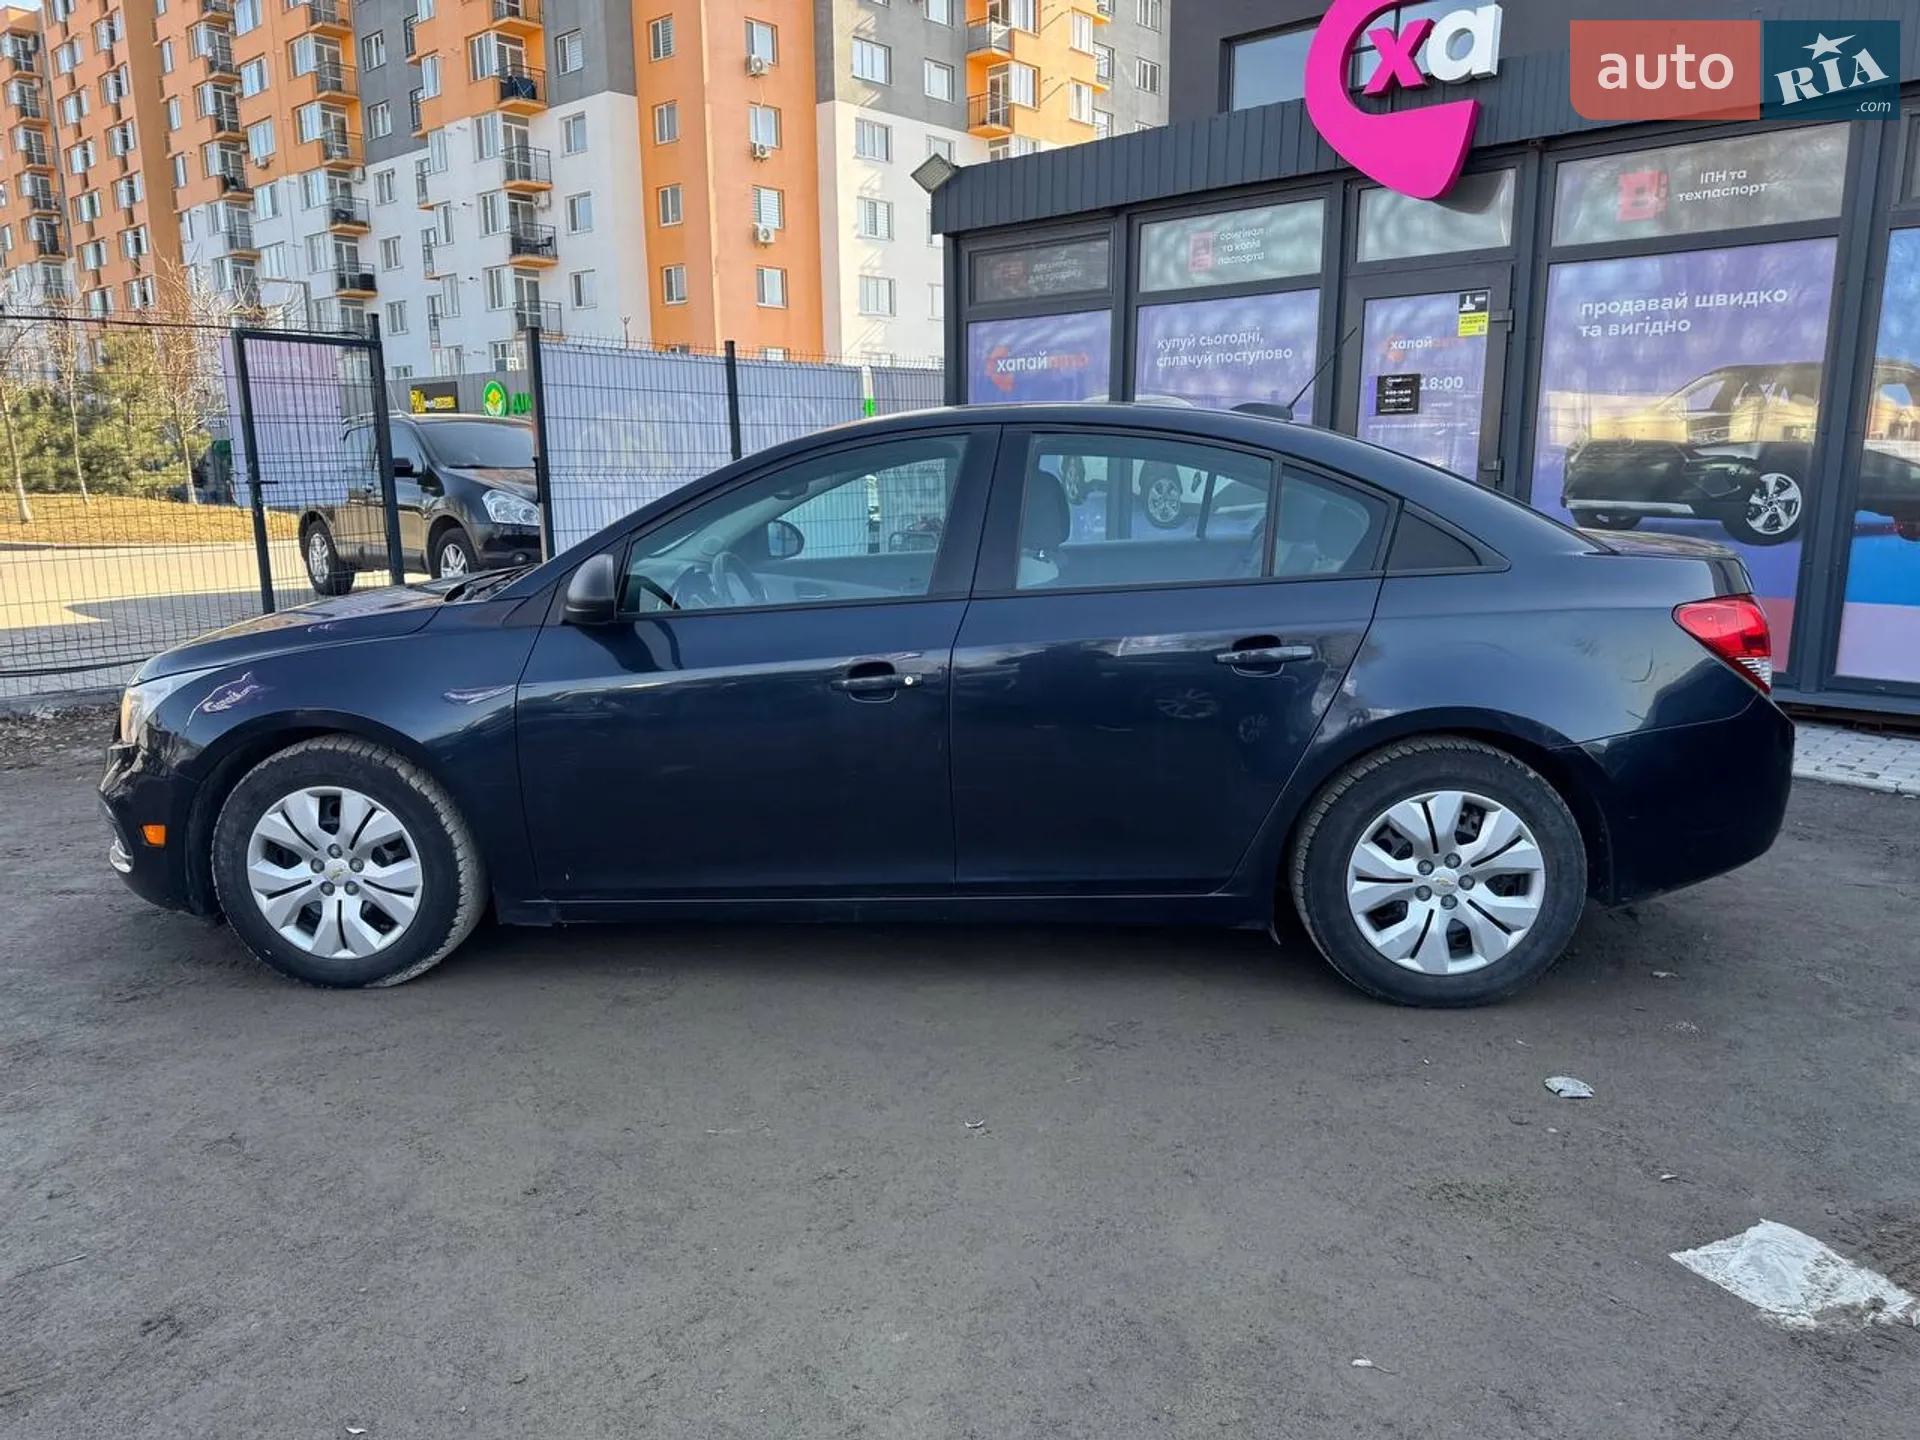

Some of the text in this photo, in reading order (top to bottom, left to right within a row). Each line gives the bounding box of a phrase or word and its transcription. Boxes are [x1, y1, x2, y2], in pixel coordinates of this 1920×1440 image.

[1730, 169, 1747, 181] та
[1677, 183, 1769, 203] техпаспорт
[1217, 251, 1265, 266] паспорта
[1580, 288, 1789, 319] продавай швидко
[1580, 316, 1692, 338] та вигідно
[1156, 335, 1195, 353] купуй
[1156, 348, 1293, 369] сплачуй поступово
